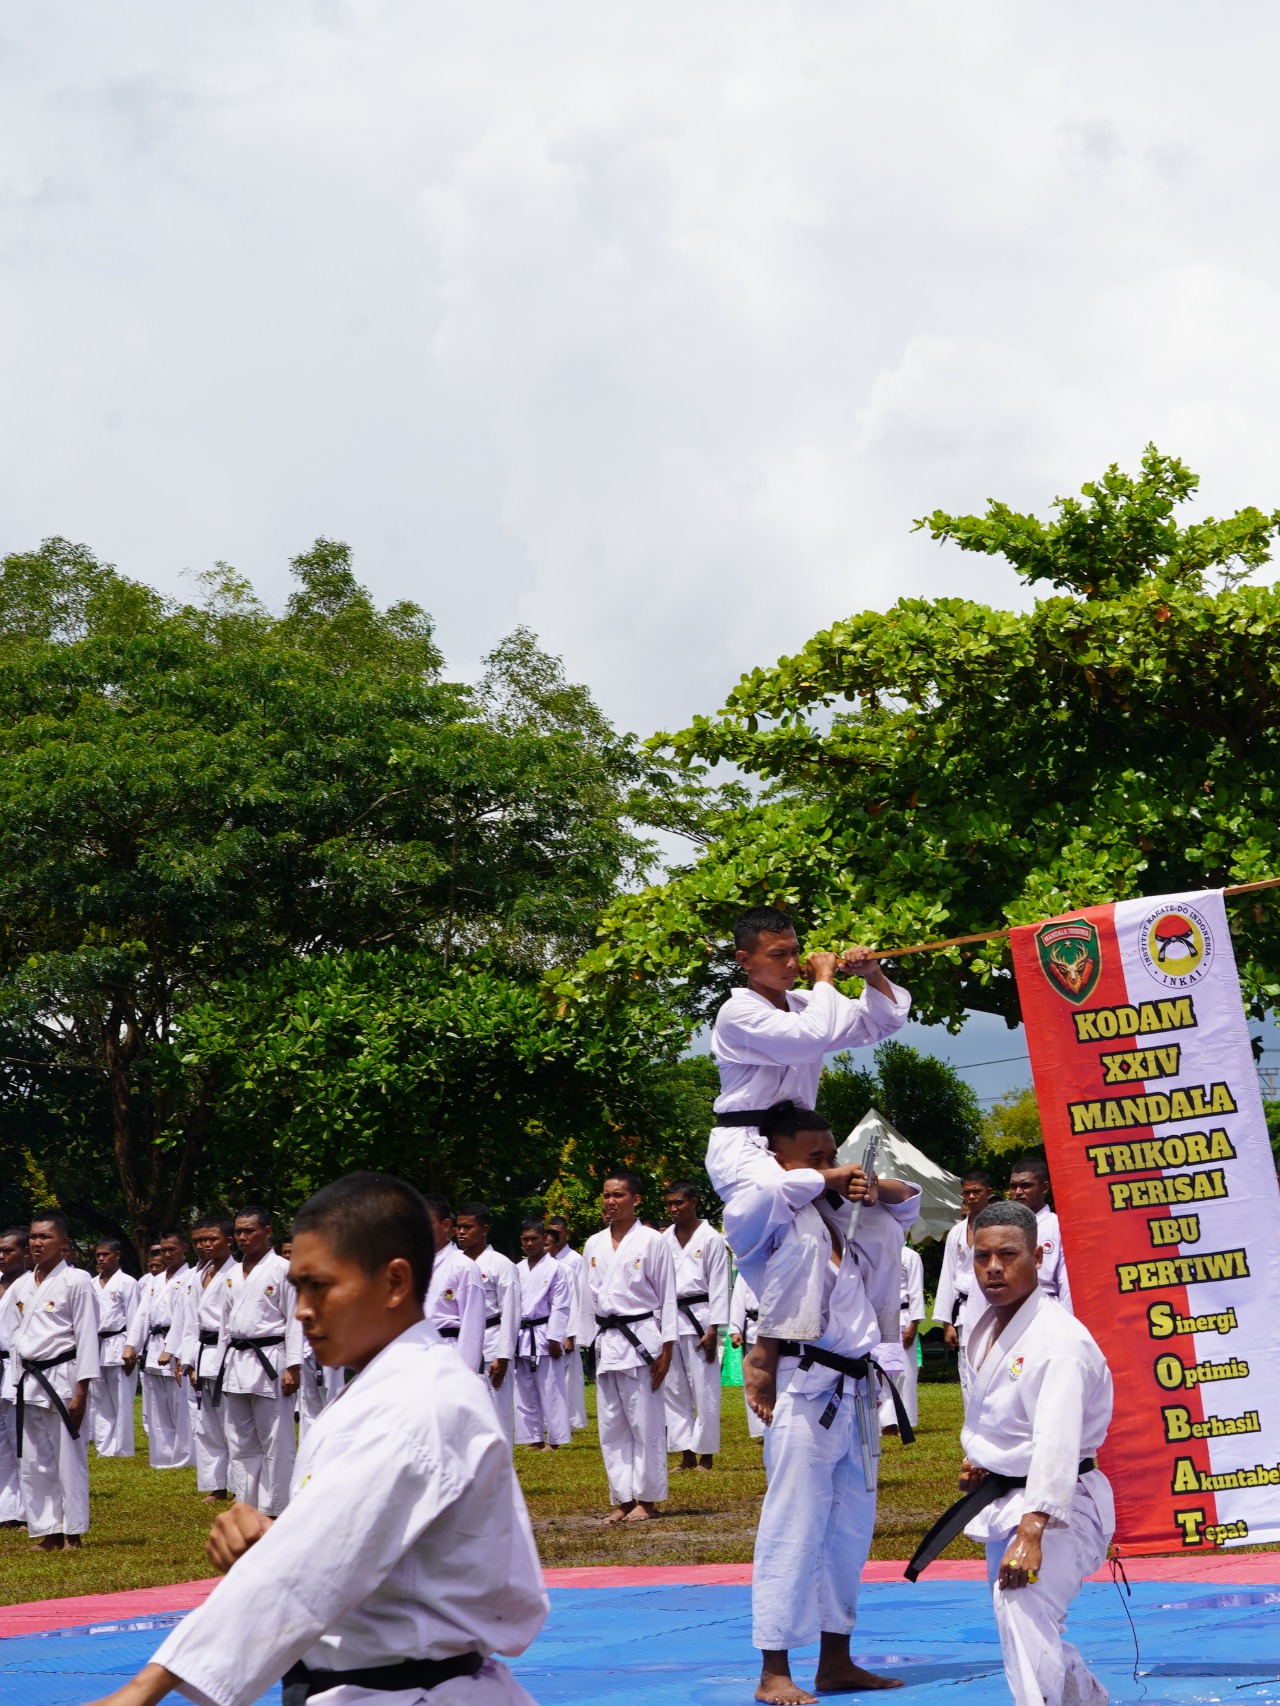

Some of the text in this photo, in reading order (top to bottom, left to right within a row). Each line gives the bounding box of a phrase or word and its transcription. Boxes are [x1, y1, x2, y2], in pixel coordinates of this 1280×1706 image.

[1044, 928, 1068, 942] MANDALA
[1141, 905, 1211, 966] INSTITUT KARATE-DO INDONESIA
[1163, 969, 1202, 986] INKAI
[1073, 996, 1197, 1043] KODAM
[1101, 1044, 1180, 1085] XXIV
[1068, 1082, 1237, 1134] MANDALA
[1087, 1129, 1236, 1176] TRIKORA
[1109, 1169, 1228, 1210] PERISAI
[1148, 1214, 1200, 1246] IBU
[1116, 1249, 1249, 1293] PERTIWI
[1148, 1302, 1237, 1339] Sinergi
[1155, 1353, 1249, 1390] Optimis
[1161, 1405, 1260, 1442] Berhasil
[1175, 1508, 1248, 1545] Tepat
